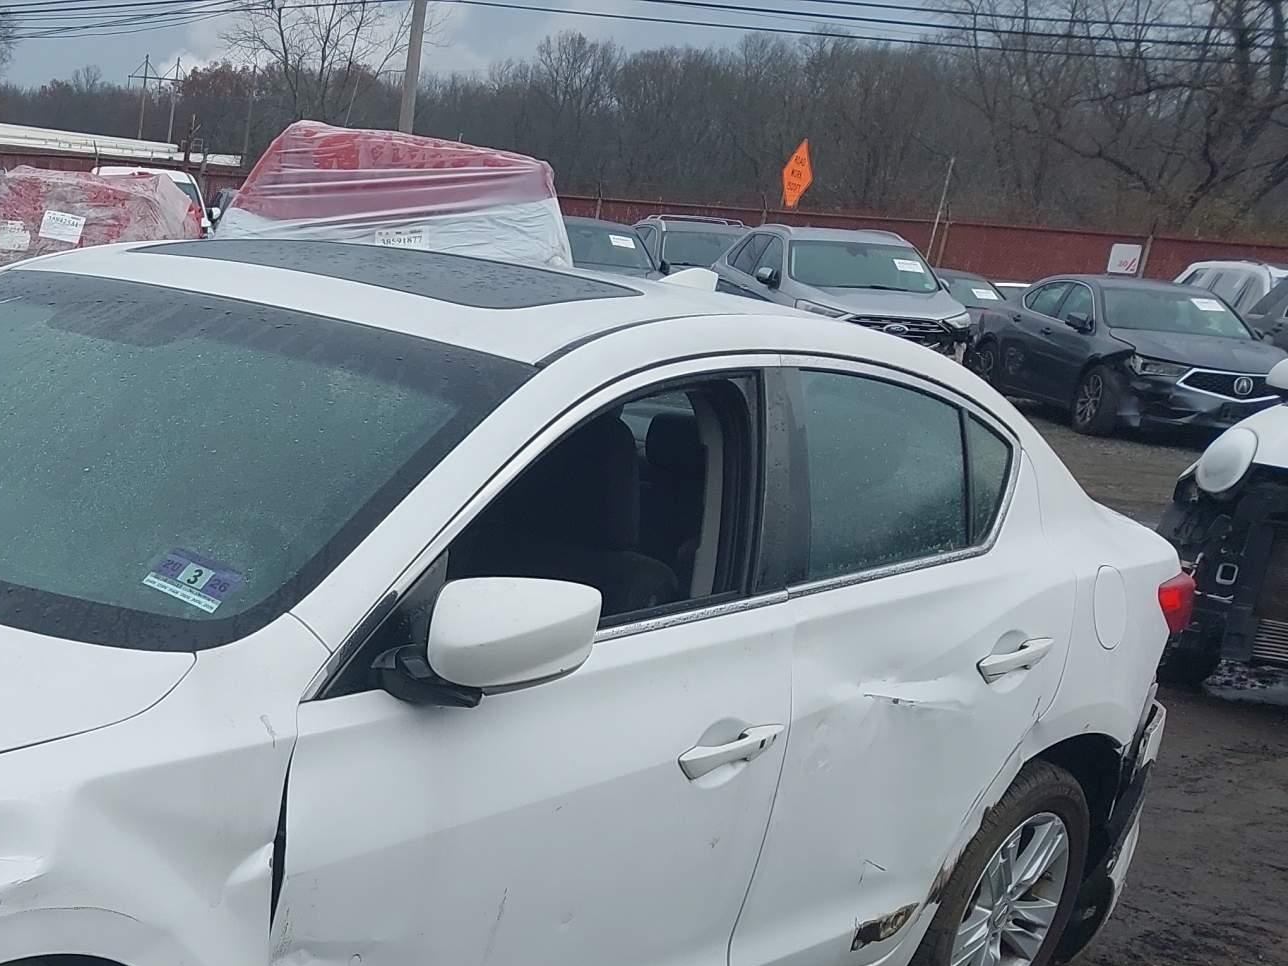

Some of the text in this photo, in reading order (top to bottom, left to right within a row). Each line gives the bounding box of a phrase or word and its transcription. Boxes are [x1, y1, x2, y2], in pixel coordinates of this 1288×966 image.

[162, 559, 183, 572] 20
[186, 569, 204, 585] 3
[208, 578, 230, 593] 26
